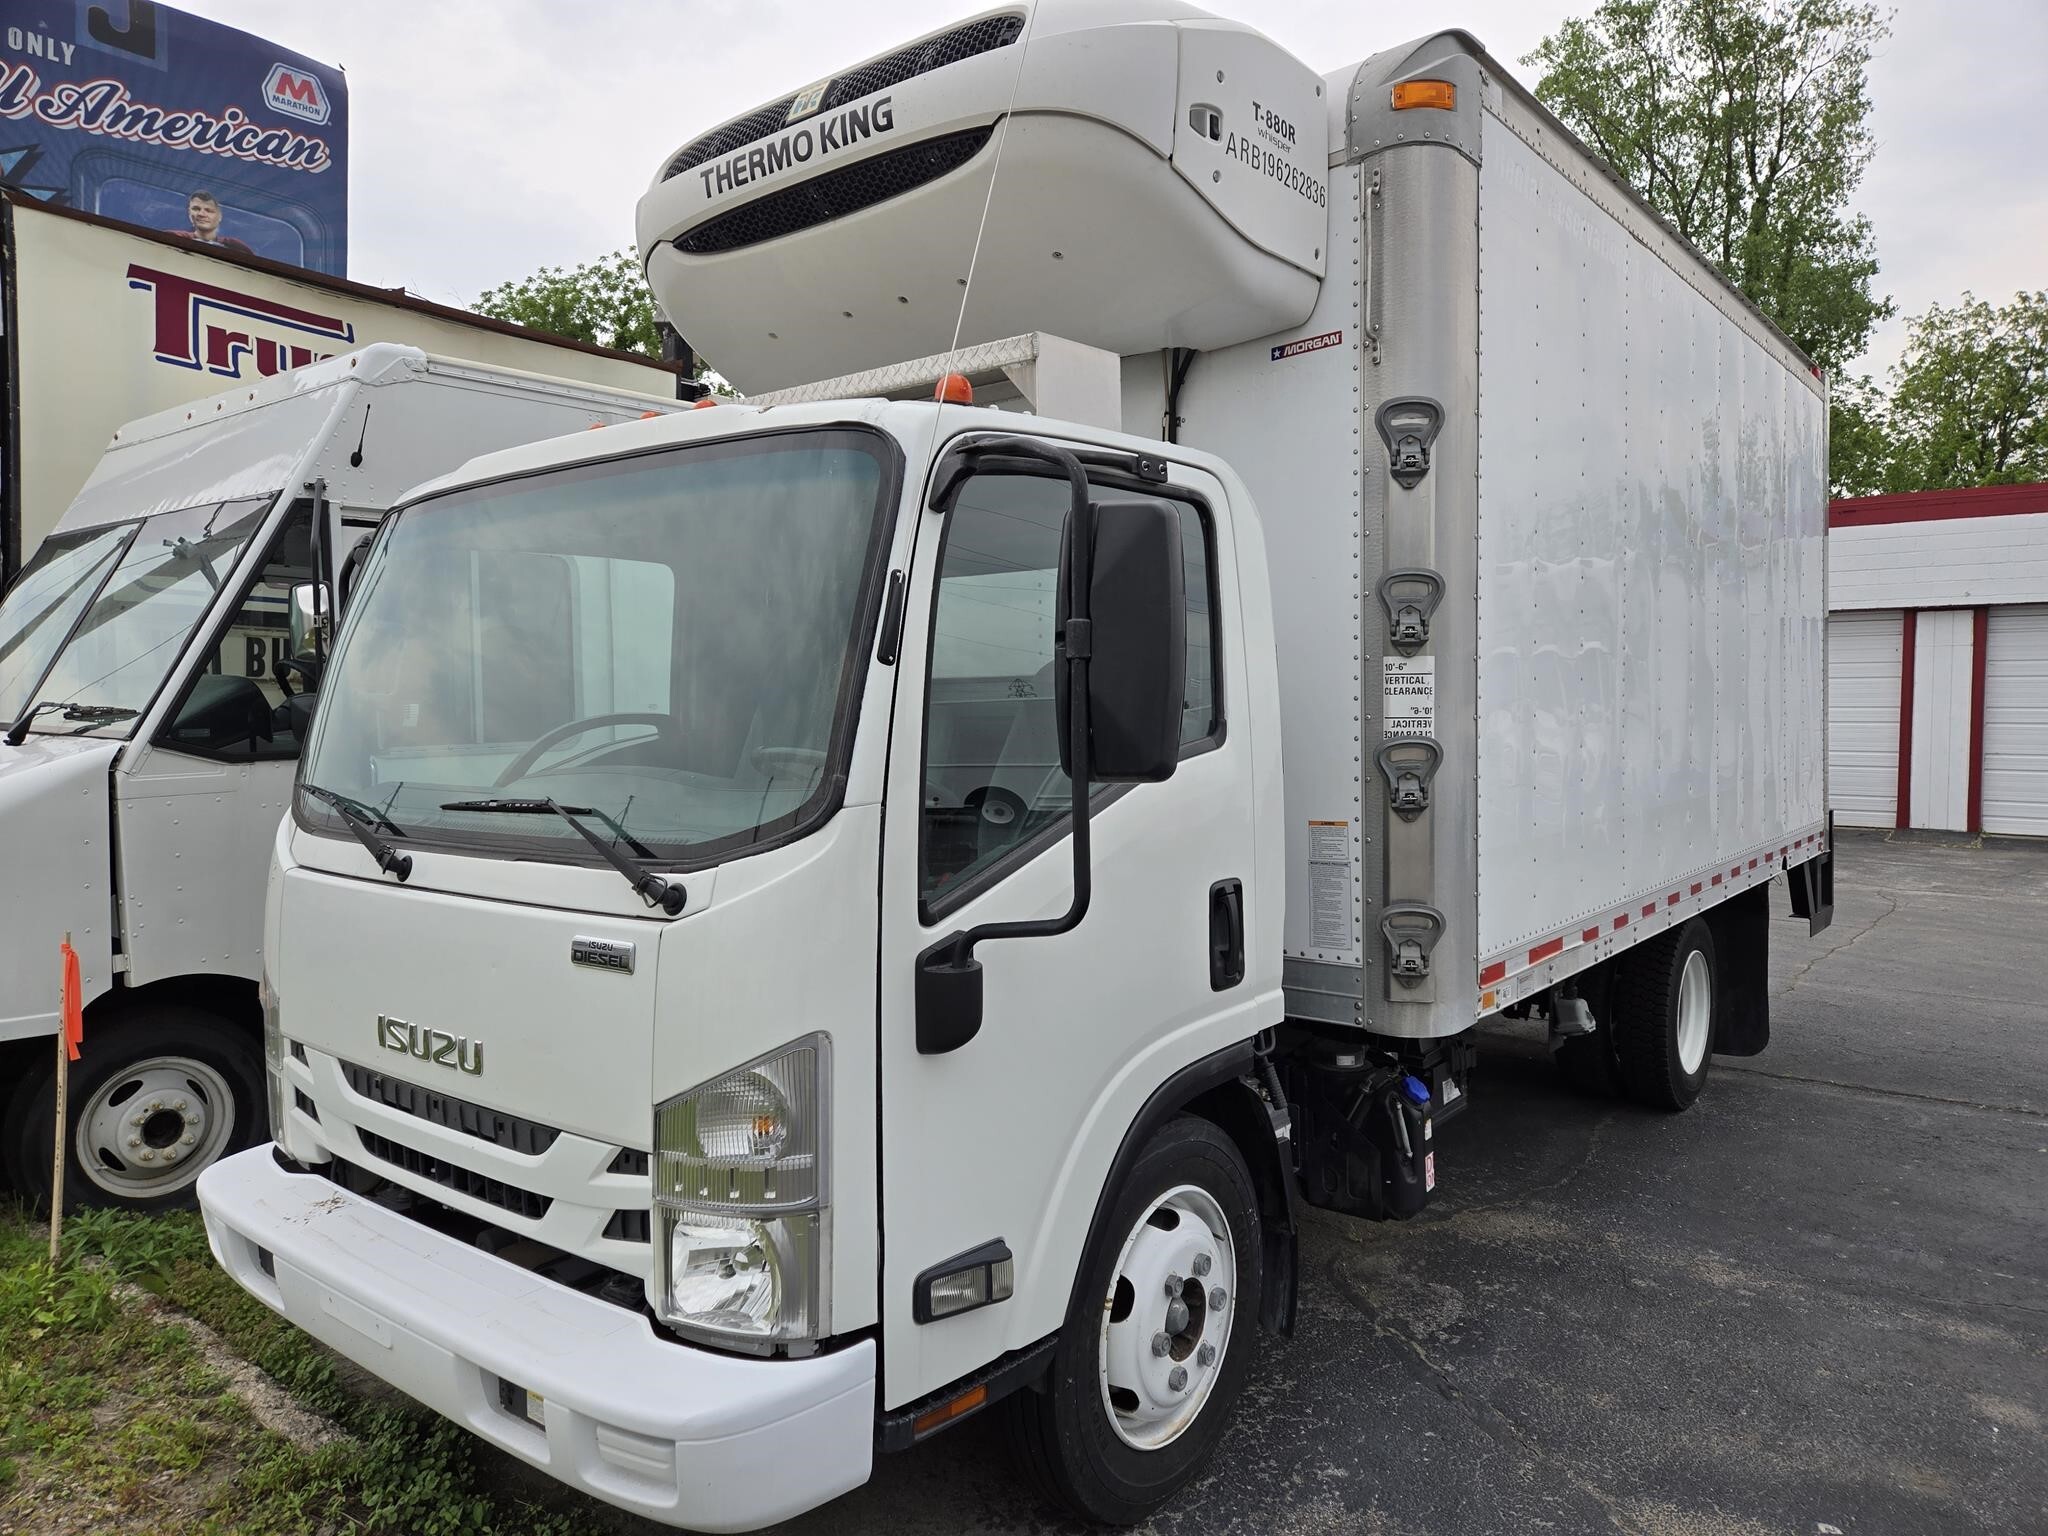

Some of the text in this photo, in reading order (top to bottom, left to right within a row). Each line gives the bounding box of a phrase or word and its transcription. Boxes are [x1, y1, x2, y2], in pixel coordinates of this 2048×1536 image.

[8, 26, 76, 66] ONLY
[272, 94, 320, 116] MARATHON
[36, 79, 331, 173] American
[1252, 100, 1296, 145] T-880R
[700, 96, 894, 199] THERMO KING
[1257, 127, 1291, 154] whisper
[1225, 131, 1326, 208] ARB196262836
[1284, 333, 1340, 356] MORGAN
[1384, 676, 1425, 685] VERTICAL
[1384, 687, 1433, 696] CLEARANCE
[573, 949, 630, 969] DIESEL
[588, 940, 614, 951] ISUZU
[377, 1013, 484, 1077] ISUZU
